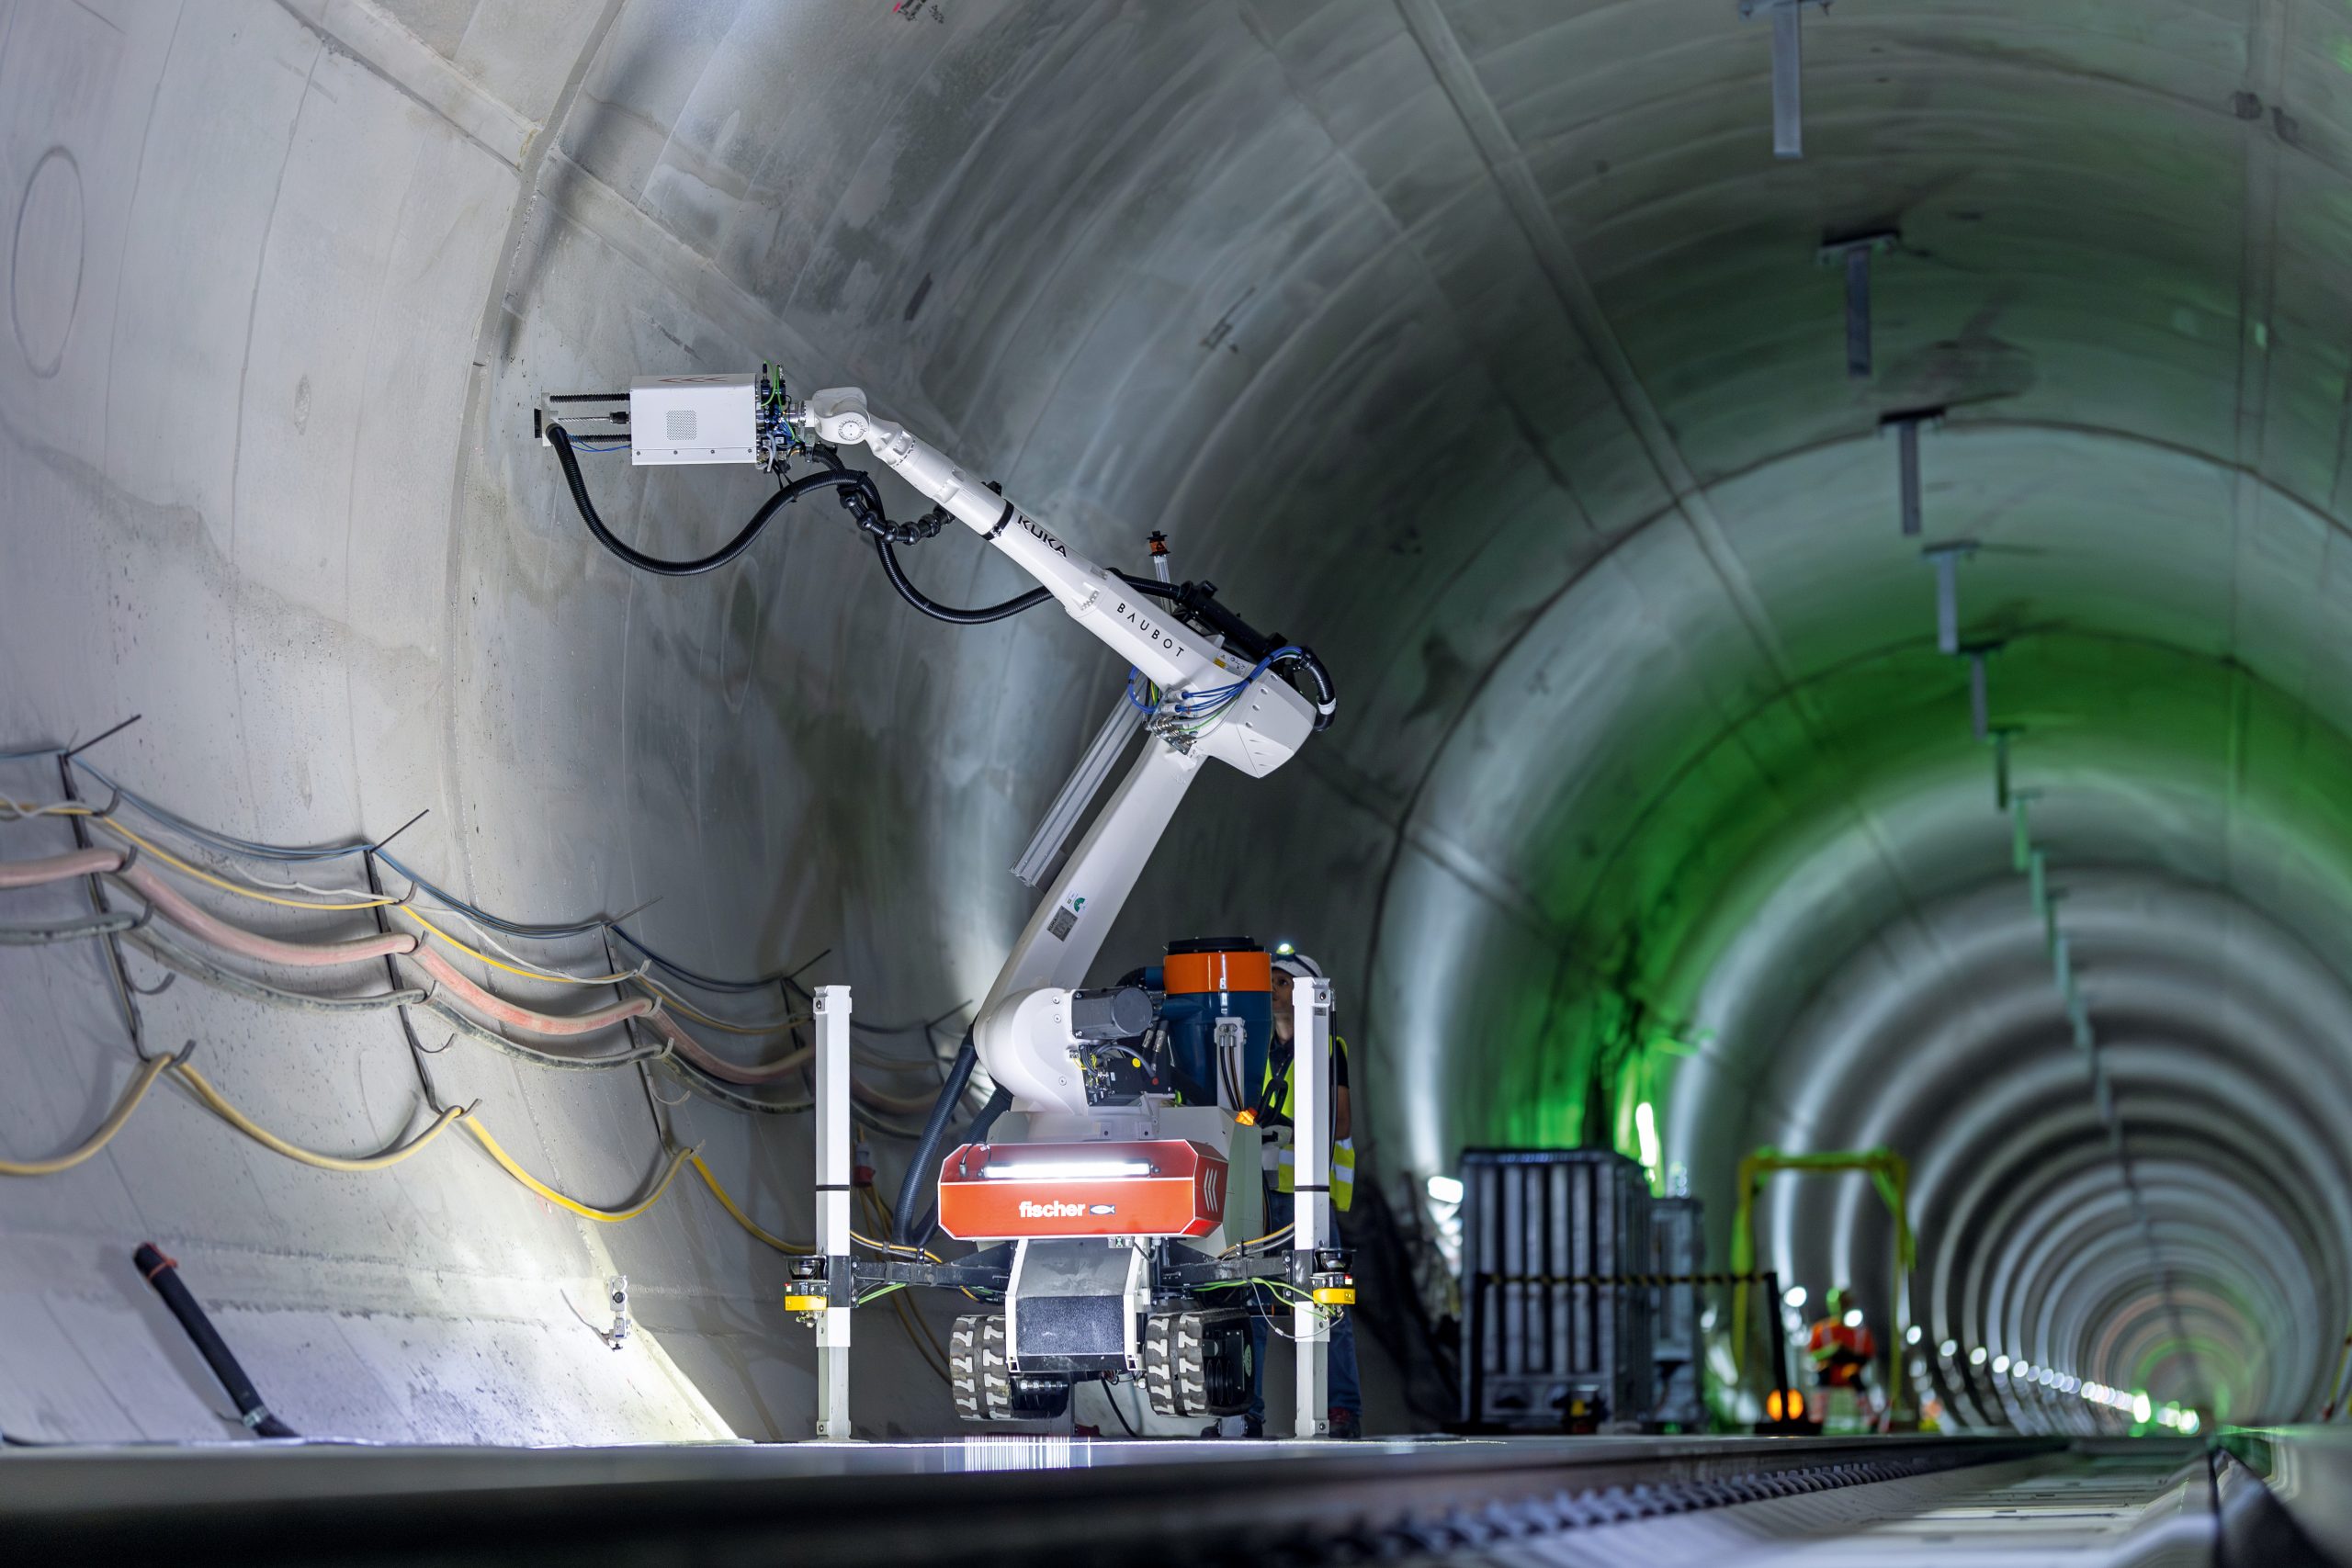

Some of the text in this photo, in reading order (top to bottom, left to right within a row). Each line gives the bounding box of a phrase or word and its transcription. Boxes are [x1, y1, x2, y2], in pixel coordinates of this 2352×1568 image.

[1017, 515, 1067, 558] KUKA
[1117, 603, 1184, 658] BAUBOT
[1019, 1201, 1086, 1217] fischer
